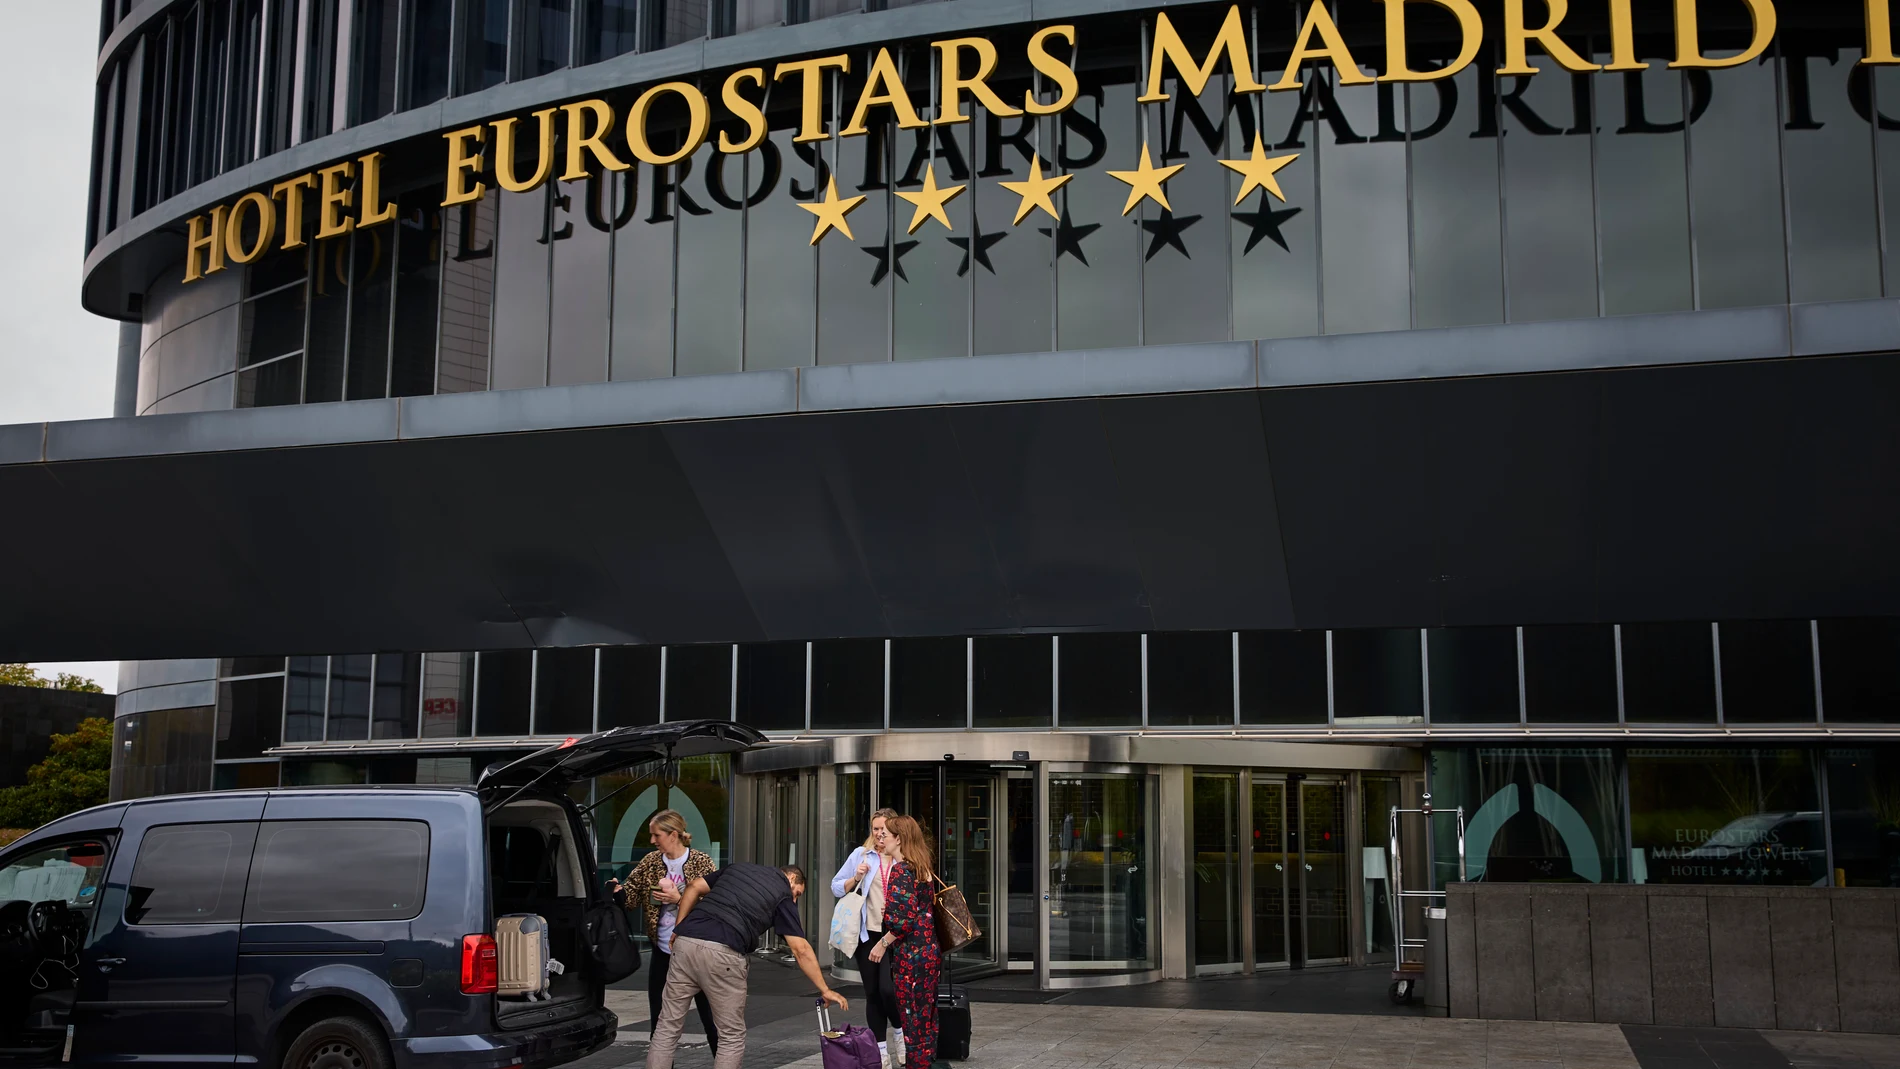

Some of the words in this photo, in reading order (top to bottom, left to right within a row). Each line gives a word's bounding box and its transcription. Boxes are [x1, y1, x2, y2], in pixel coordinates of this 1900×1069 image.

[182, 151, 398, 284] HOTEL
[440, 25, 1079, 207] EUROSTARS
[1137, 0, 1777, 103] MADRID
[1675, 828, 1780, 843] EUROSTARS
[1651, 845, 1730, 861] MADRID
[1736, 846, 1805, 861] TOWER
[1671, 865, 1717, 877] HOTEL
